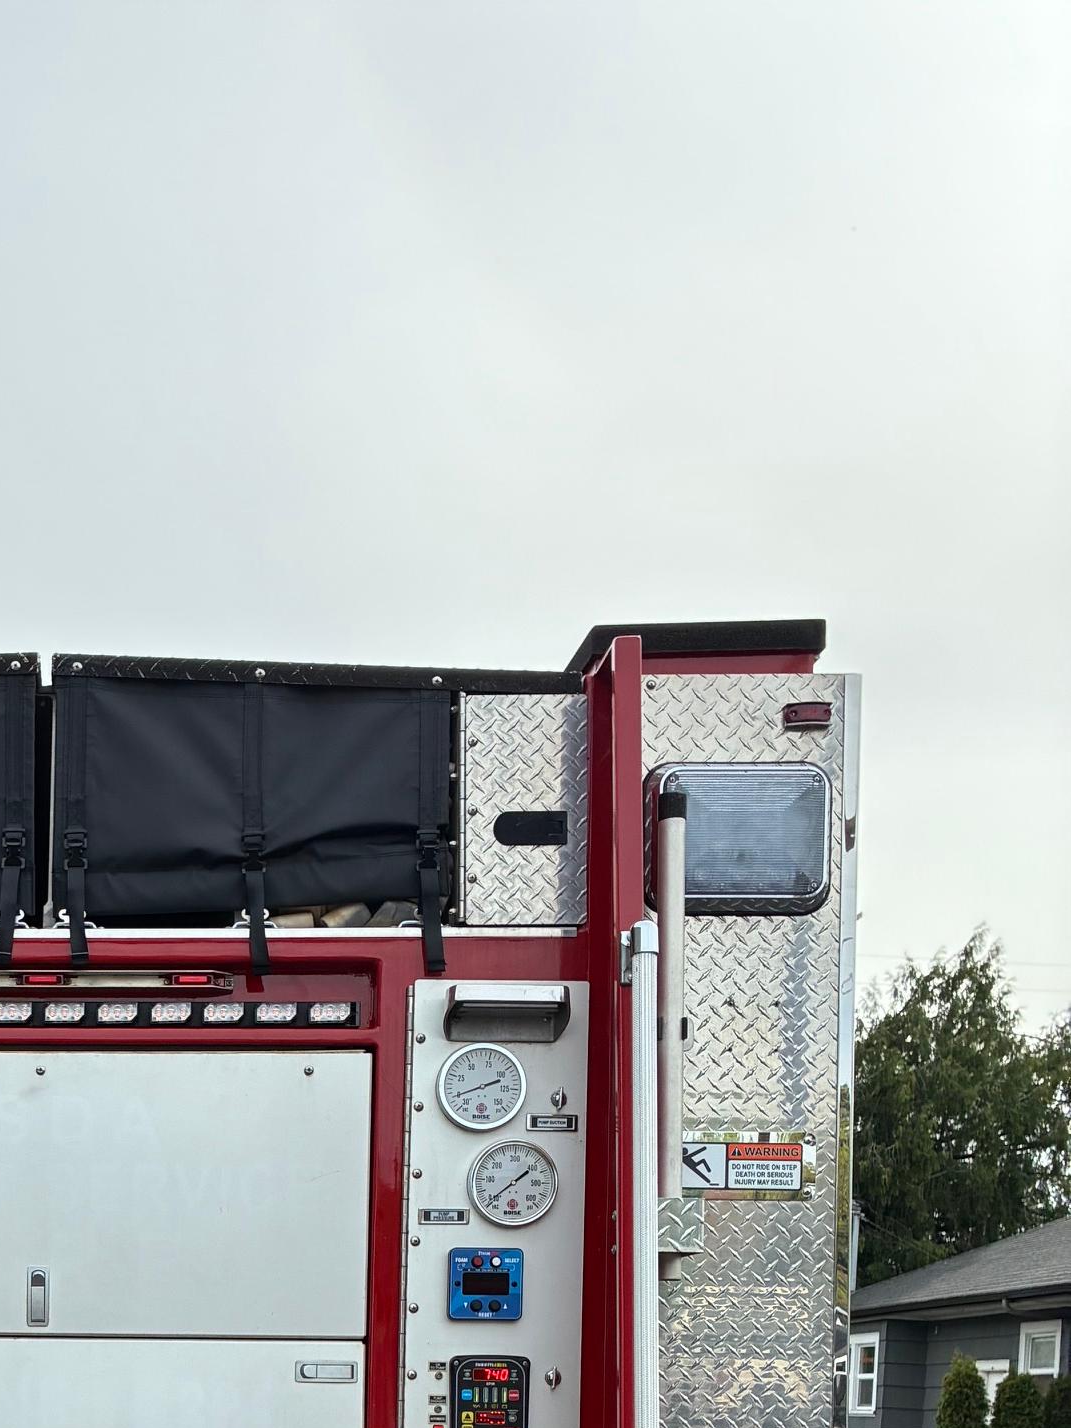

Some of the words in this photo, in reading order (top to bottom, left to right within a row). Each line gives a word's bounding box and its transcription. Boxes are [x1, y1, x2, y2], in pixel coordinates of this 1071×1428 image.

[468, 1063, 476, 1071] 50
[485, 1060, 493, 1069] 75
[493, 1098, 503, 1106] 150
[745, 1147, 799, 1157] WARNING
[510, 1155, 520, 1163] 300
[485, 1369, 509, 1380] 740
